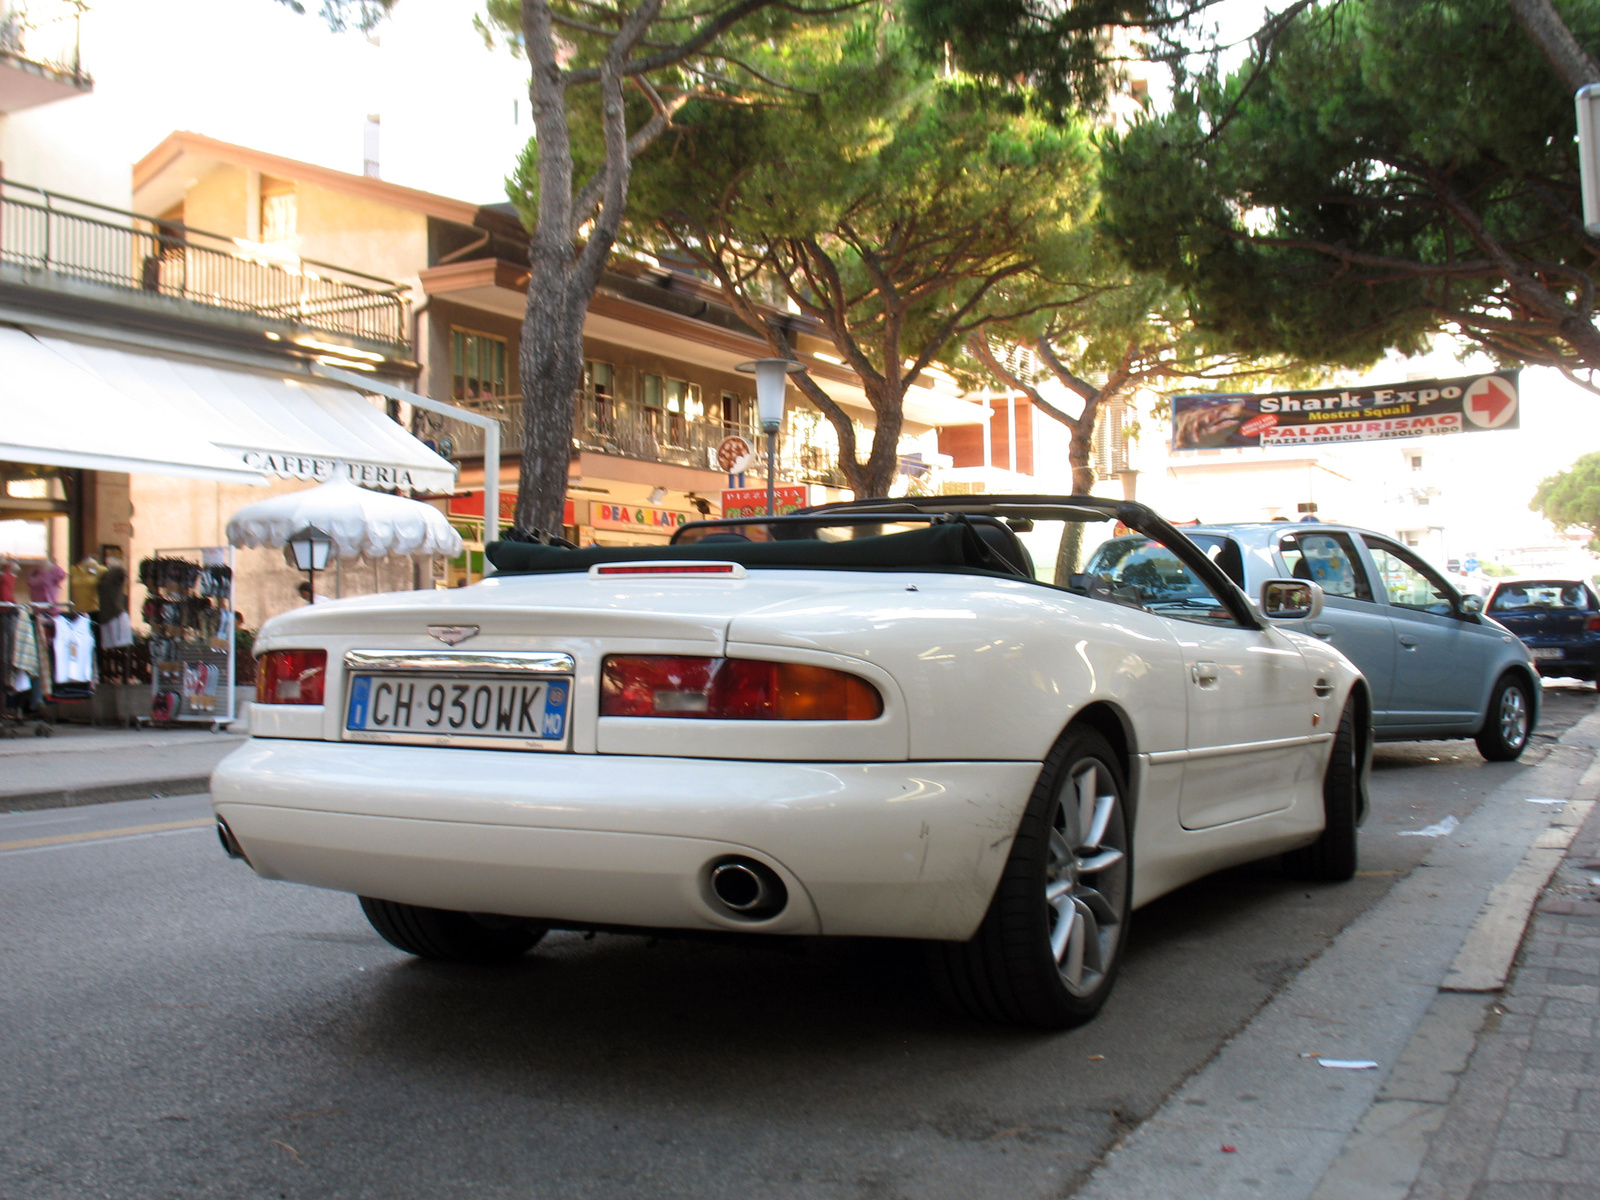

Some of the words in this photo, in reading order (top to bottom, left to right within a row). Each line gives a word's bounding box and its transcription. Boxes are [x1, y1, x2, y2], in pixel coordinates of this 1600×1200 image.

[1260, 391, 1362, 413] Shark
[1373, 386, 1462, 406] Expo
[1308, 410, 1360, 421] Mostra
[1364, 405, 1411, 418] Squali
[1263, 437, 1307, 445] PIAZZA
[1313, 434, 1362, 443] BRESCIA
[1379, 429, 1424, 439] JESOLO
[1430, 425, 1460, 434] LIDO
[1264, 415, 1459, 438] PALATURISMO
[595, 503, 631, 523] IDEA
[635, 508, 686, 528] GELATO
[373, 682, 415, 727] CH
[426, 684, 543, 733] 930WK
[543, 713, 563, 735] MO
